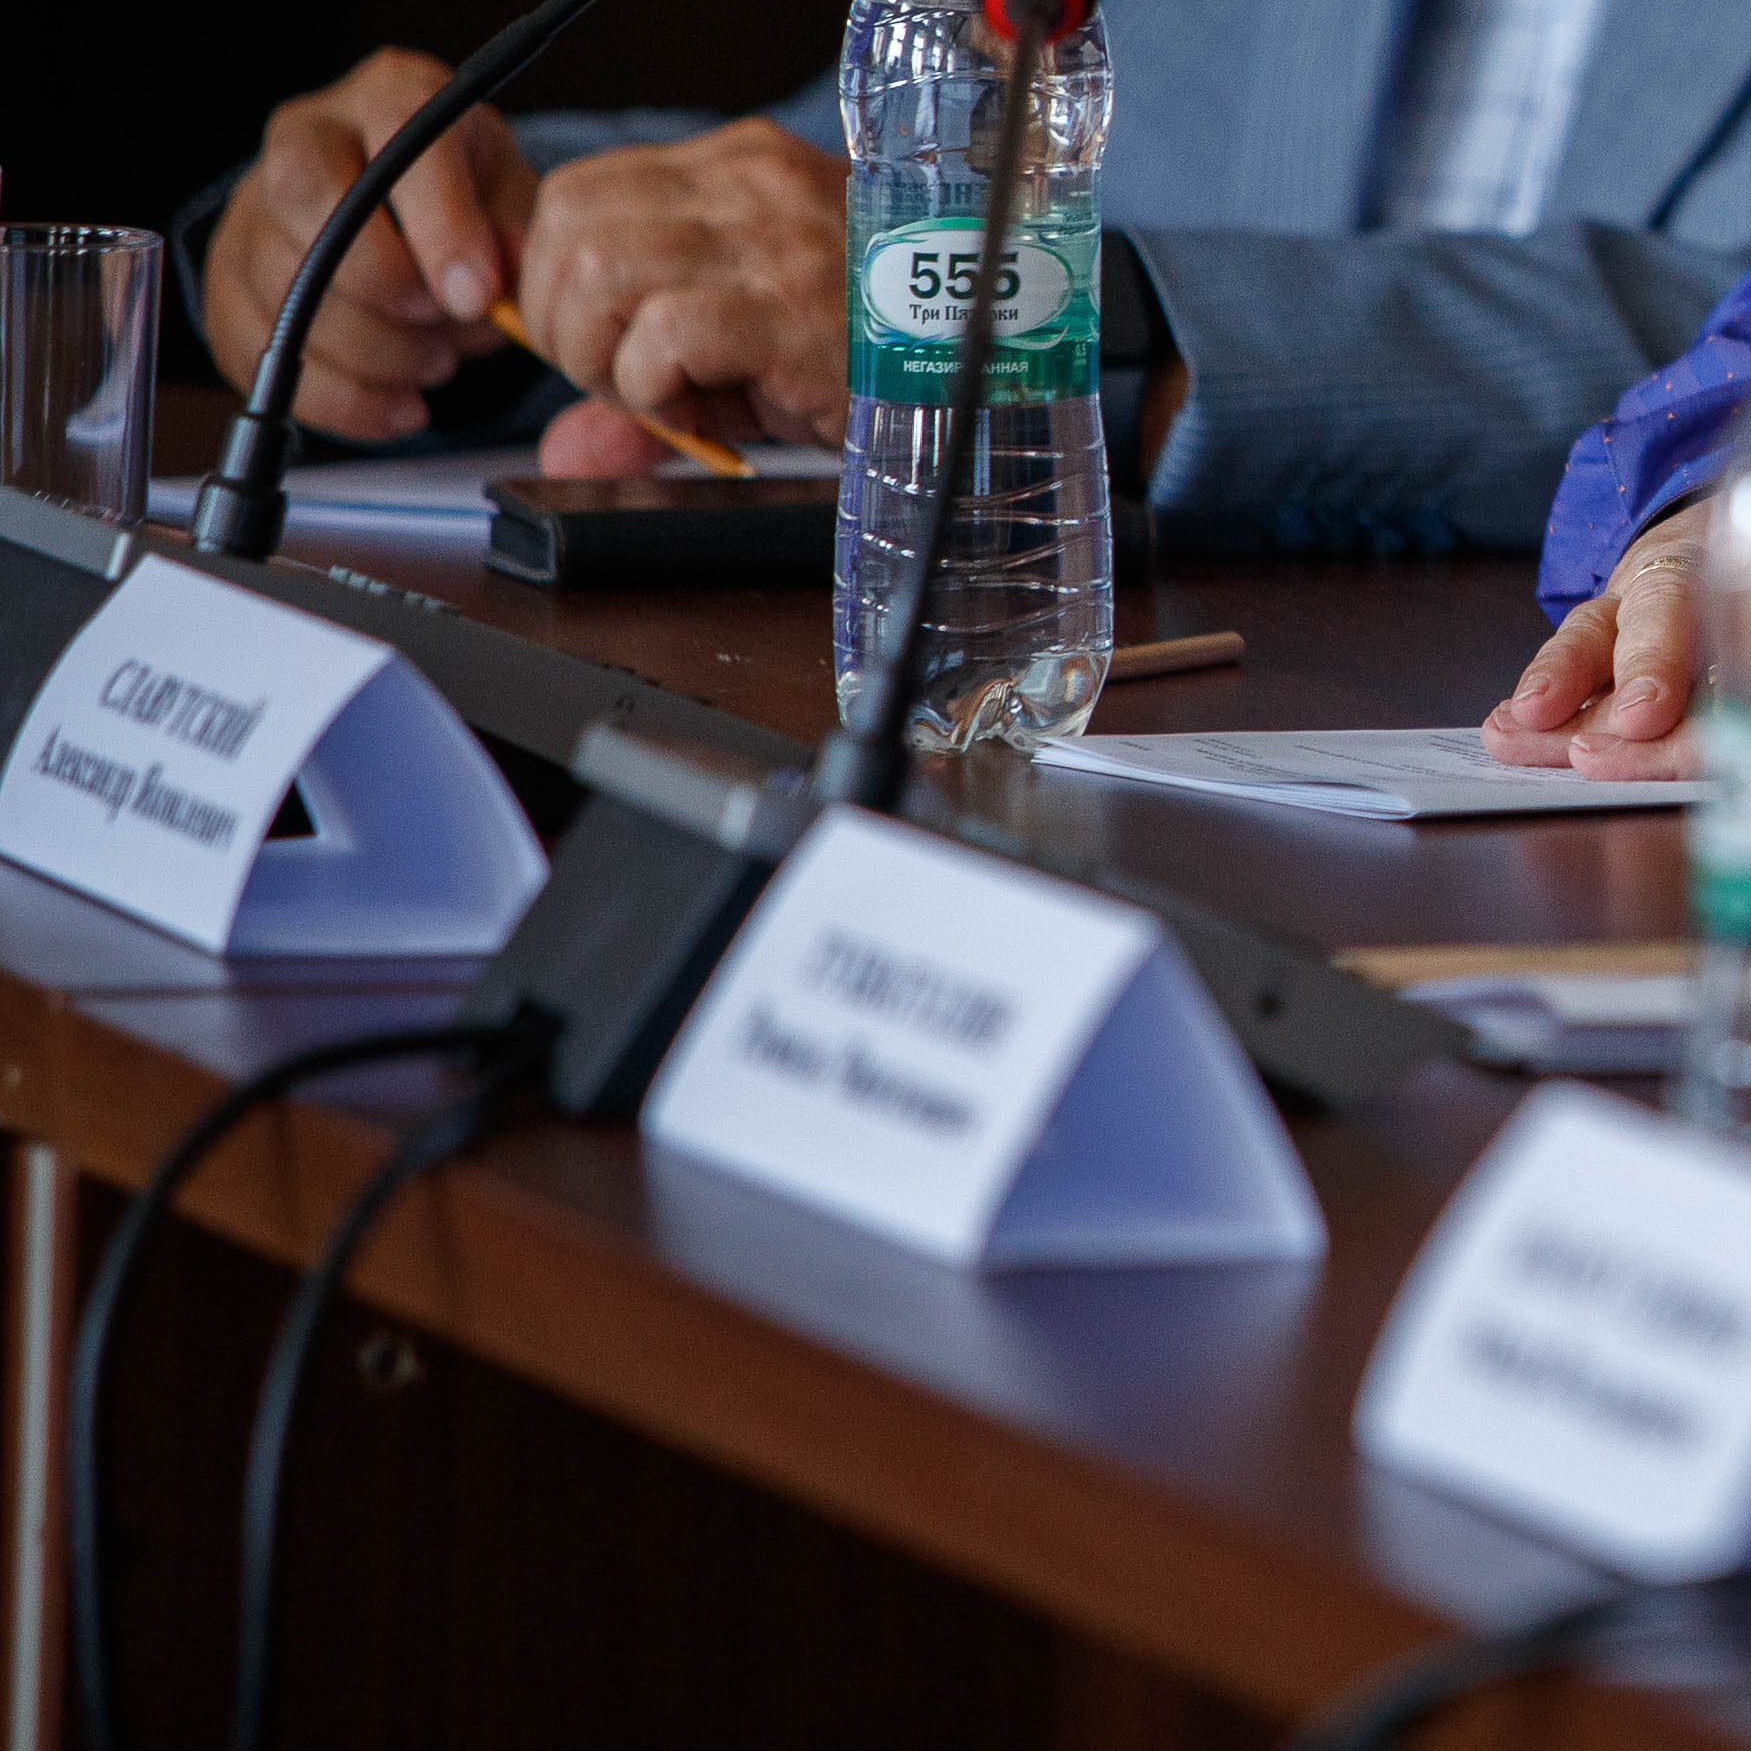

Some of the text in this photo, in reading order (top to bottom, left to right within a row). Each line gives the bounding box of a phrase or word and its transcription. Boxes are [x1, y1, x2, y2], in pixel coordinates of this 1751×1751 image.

[909, 252, 1020, 300] 555
[909, 304, 1018, 325] Три Пяки
[903, 360, 1029, 374] НЕГАЗИРАННАЯ
[32, 724, 138, 823] Александр
